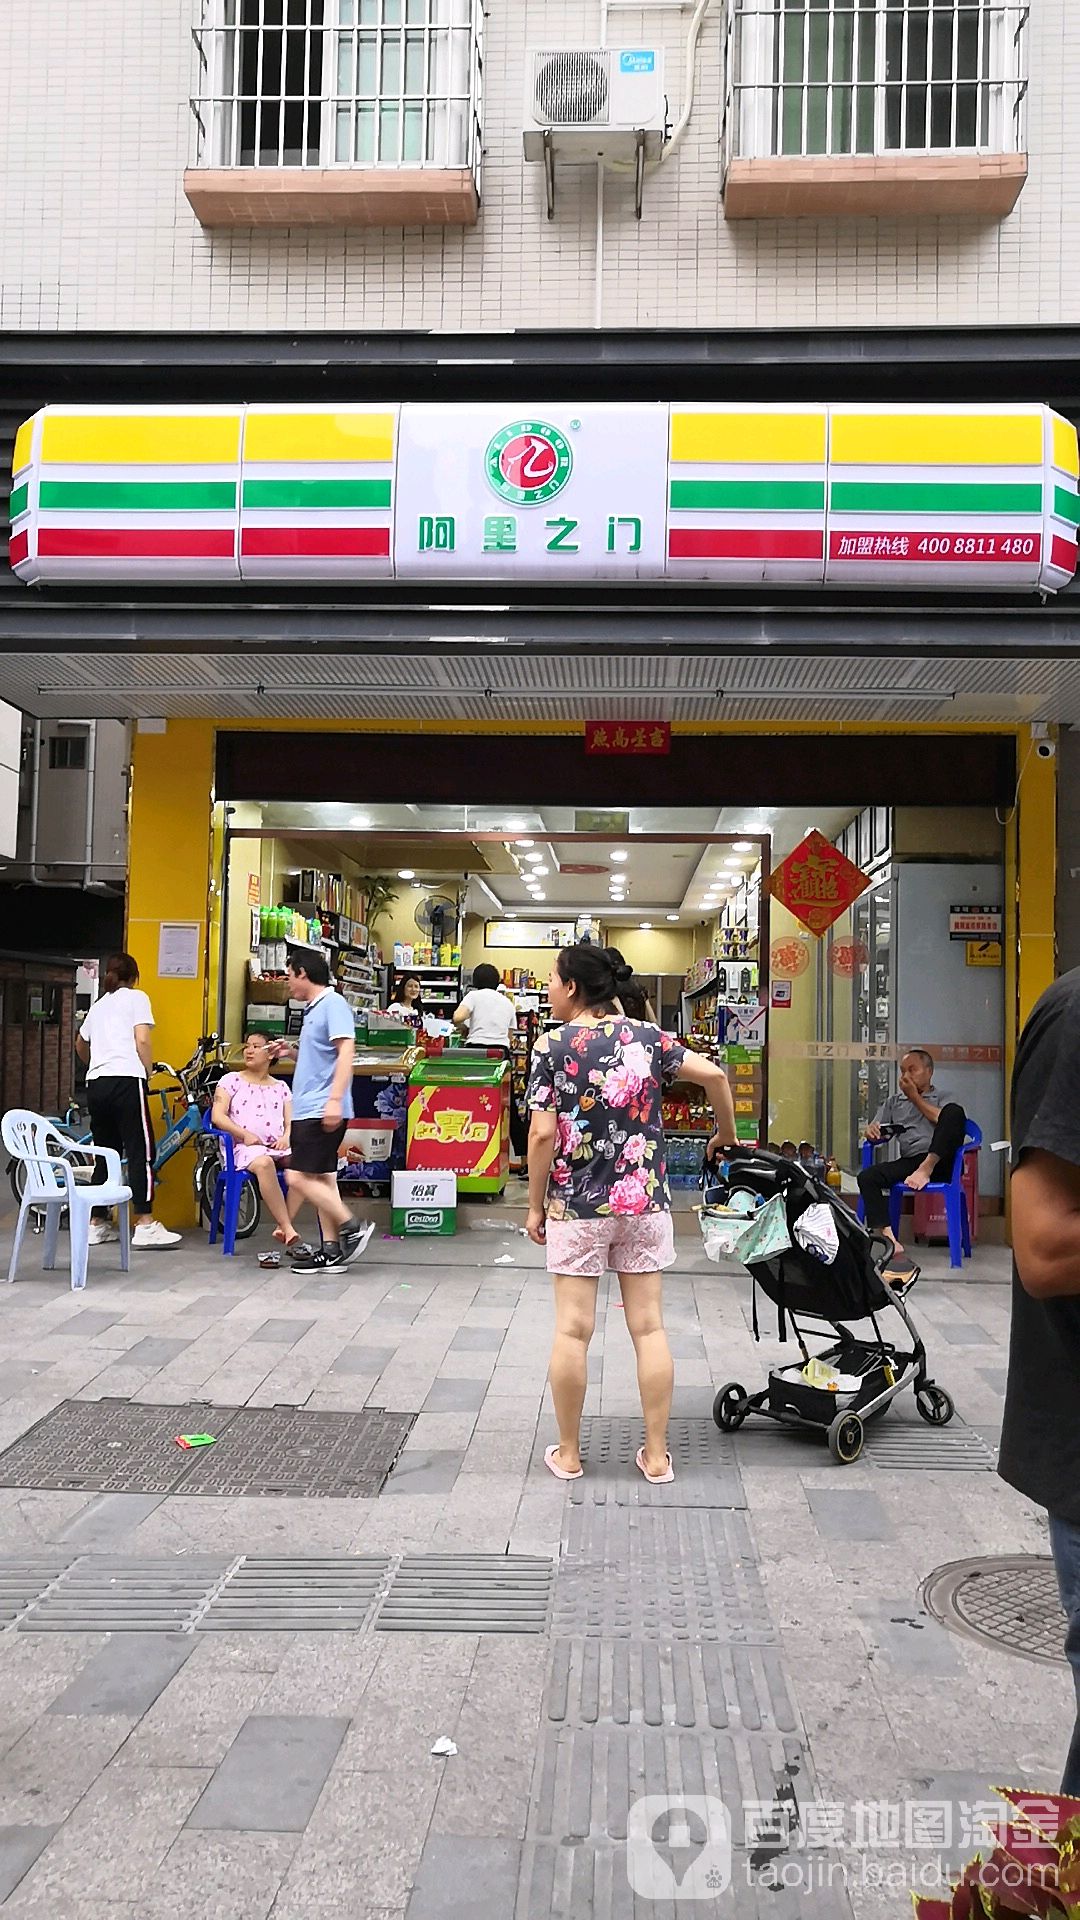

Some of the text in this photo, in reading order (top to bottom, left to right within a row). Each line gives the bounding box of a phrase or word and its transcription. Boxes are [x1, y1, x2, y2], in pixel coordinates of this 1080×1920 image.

[418, 516, 642, 552] 阿里之门
[837, 536, 1034, 556] 加盟热线 400 8811 480
